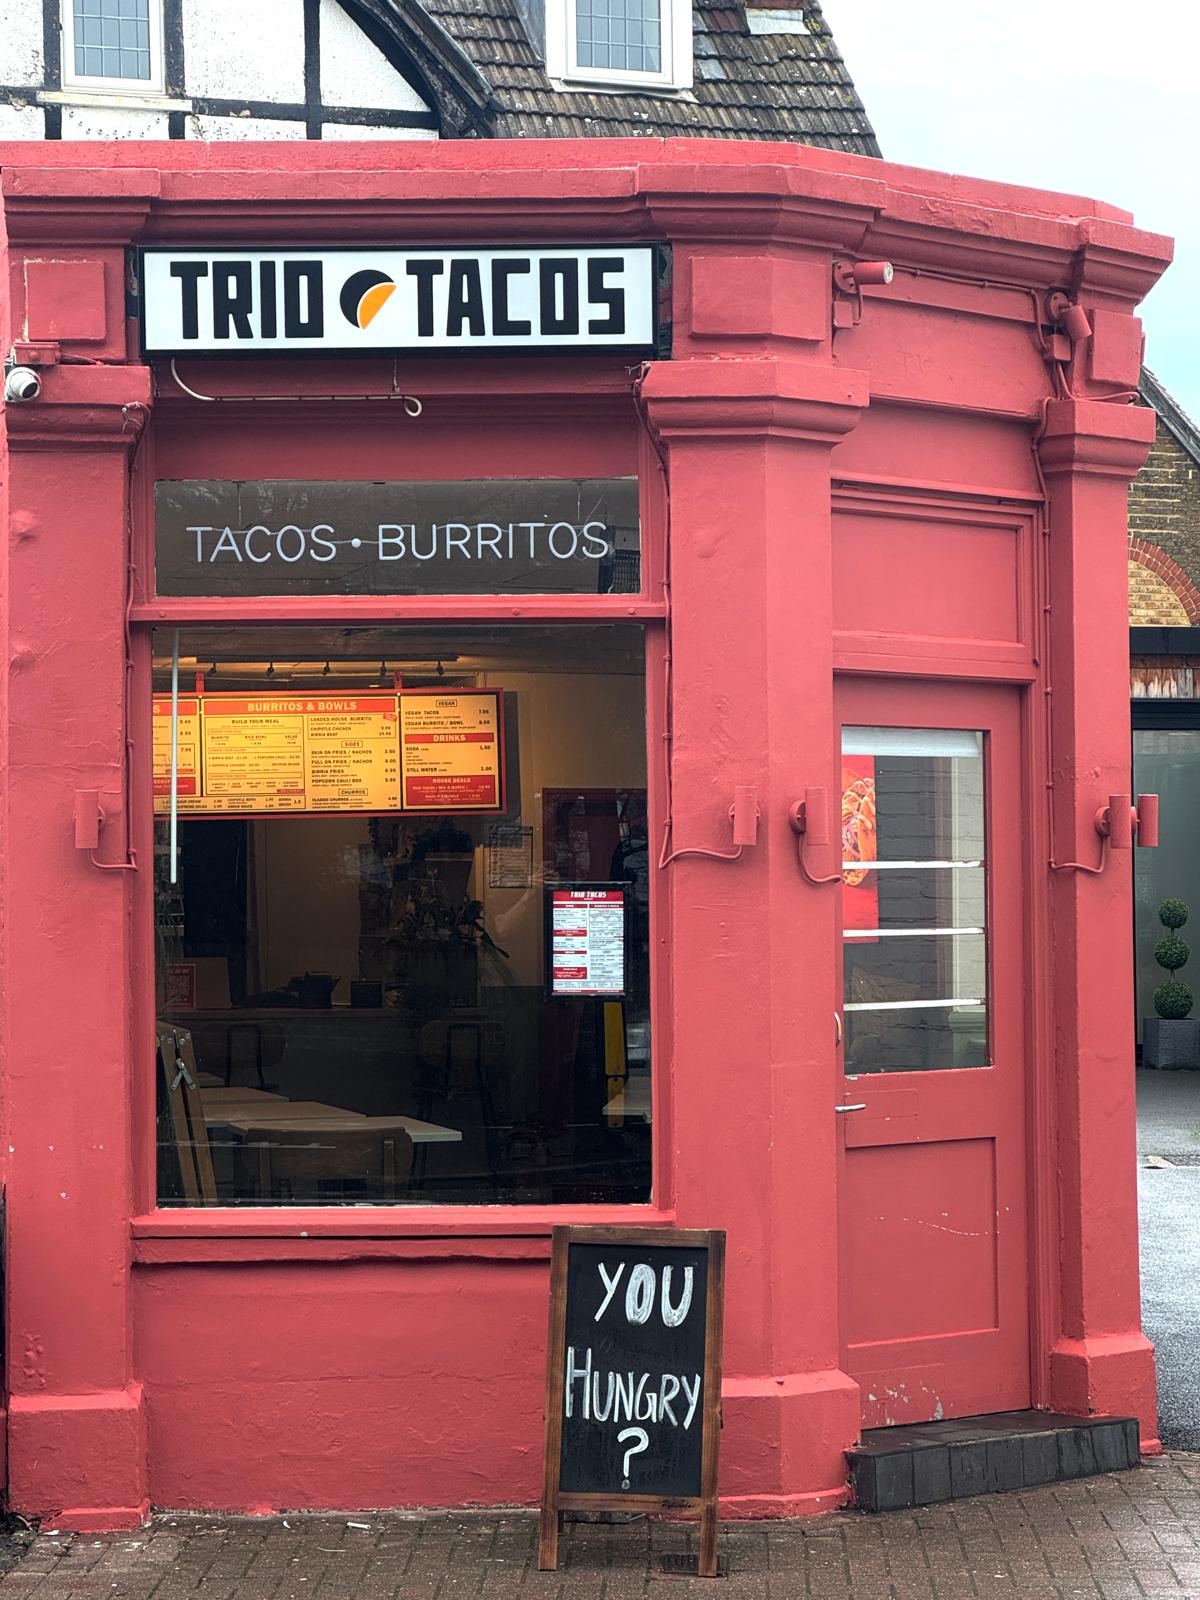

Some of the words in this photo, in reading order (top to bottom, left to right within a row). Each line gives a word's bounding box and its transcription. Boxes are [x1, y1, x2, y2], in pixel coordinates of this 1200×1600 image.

[170, 260, 324, 339] TRIO
[406, 257, 625, 337] TACOS
[186, 524, 336, 562] TACOS
[378, 521, 609, 561] BURRITOS
[247, 702, 303, 712] BURRITOS
[306, 702, 316, 711] &
[318, 701, 357, 711] BOWLS
[433, 734, 466, 742] DRINKS
[595, 1262, 694, 1328] YOU
[565, 1346, 701, 1430] HUNGRY
[617, 1426, 649, 1490] ?
